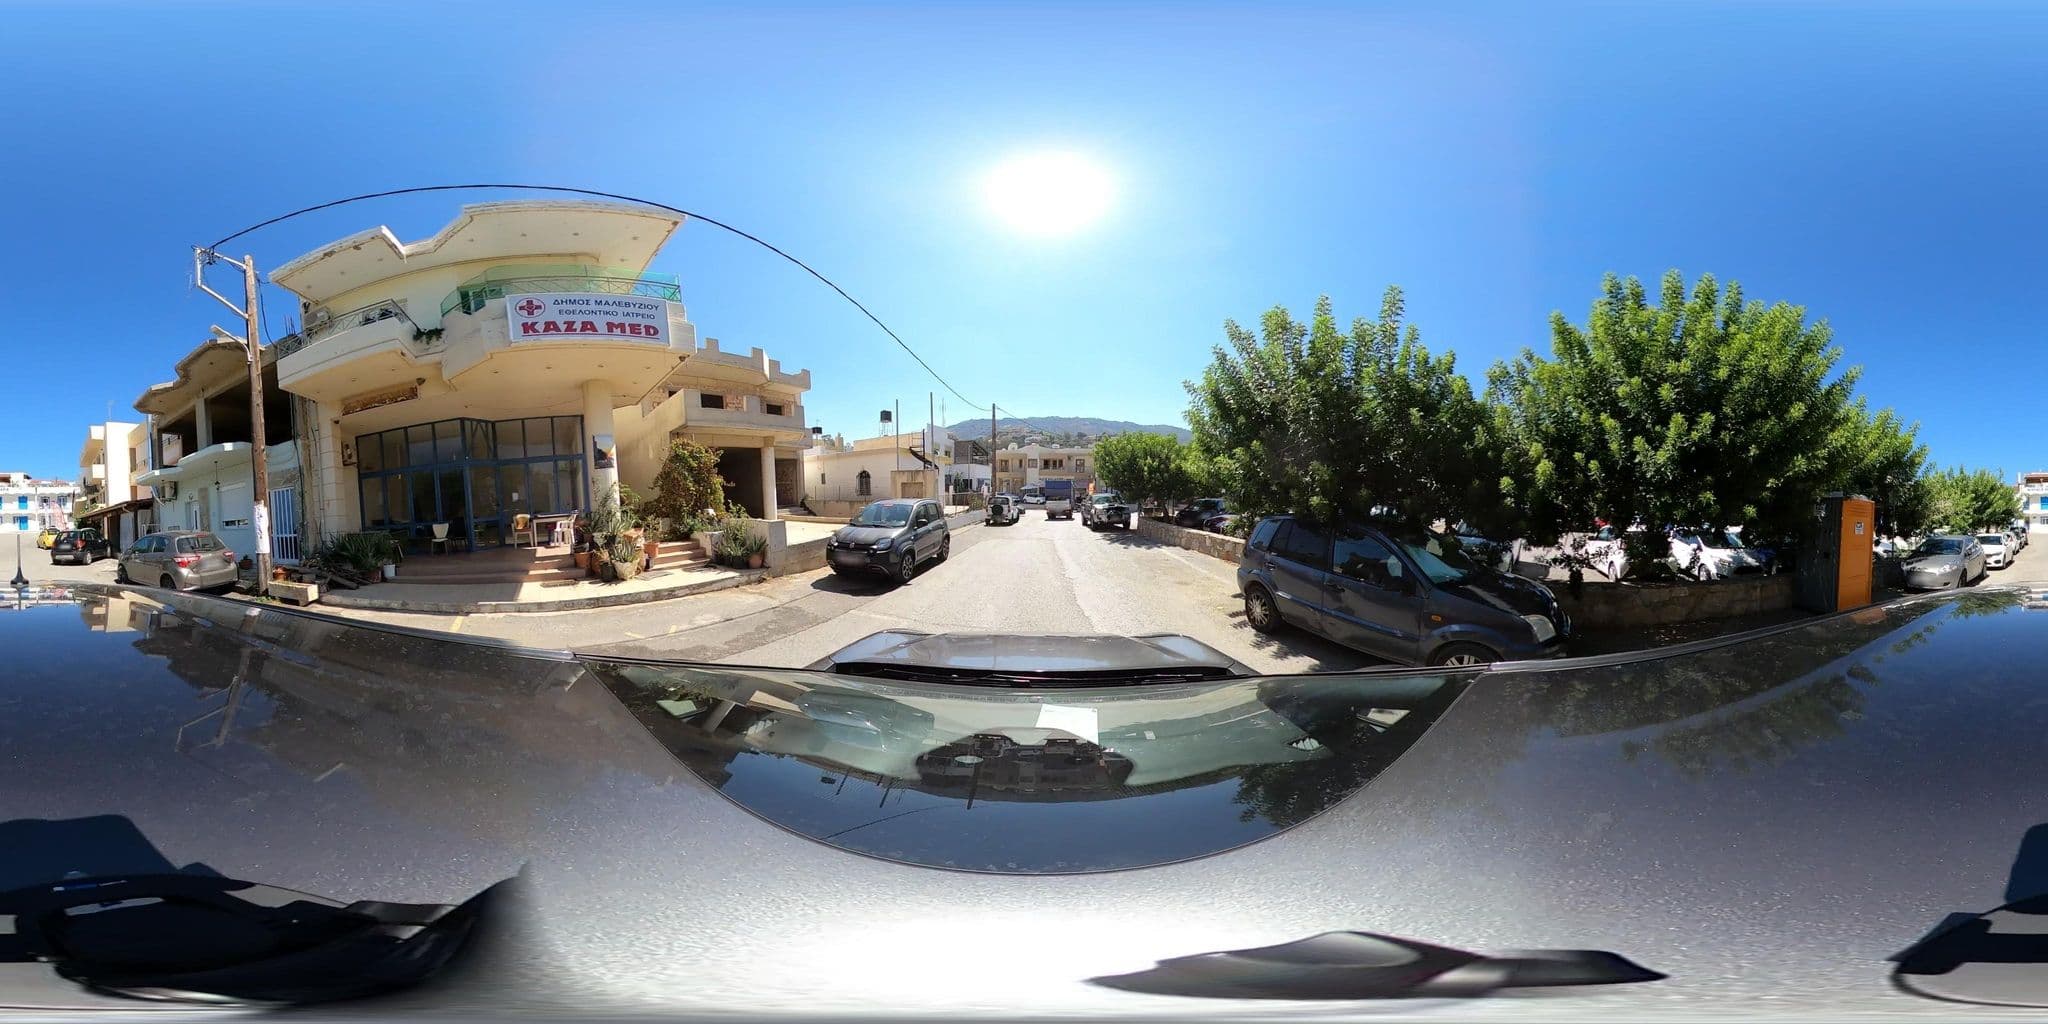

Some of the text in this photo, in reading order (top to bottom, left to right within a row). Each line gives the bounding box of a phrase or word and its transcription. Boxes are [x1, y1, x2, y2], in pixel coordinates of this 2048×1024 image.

[552, 298, 659, 311] ΔΗΜΟΣ ΜΑΛΕΒΥΖΙΟΥ
[558, 309, 656, 320] ΕΘΕΛΟΝΤΙΚΟ ΙΑΤΡΕΙΟ
[521, 320, 660, 336] KAZA MED
